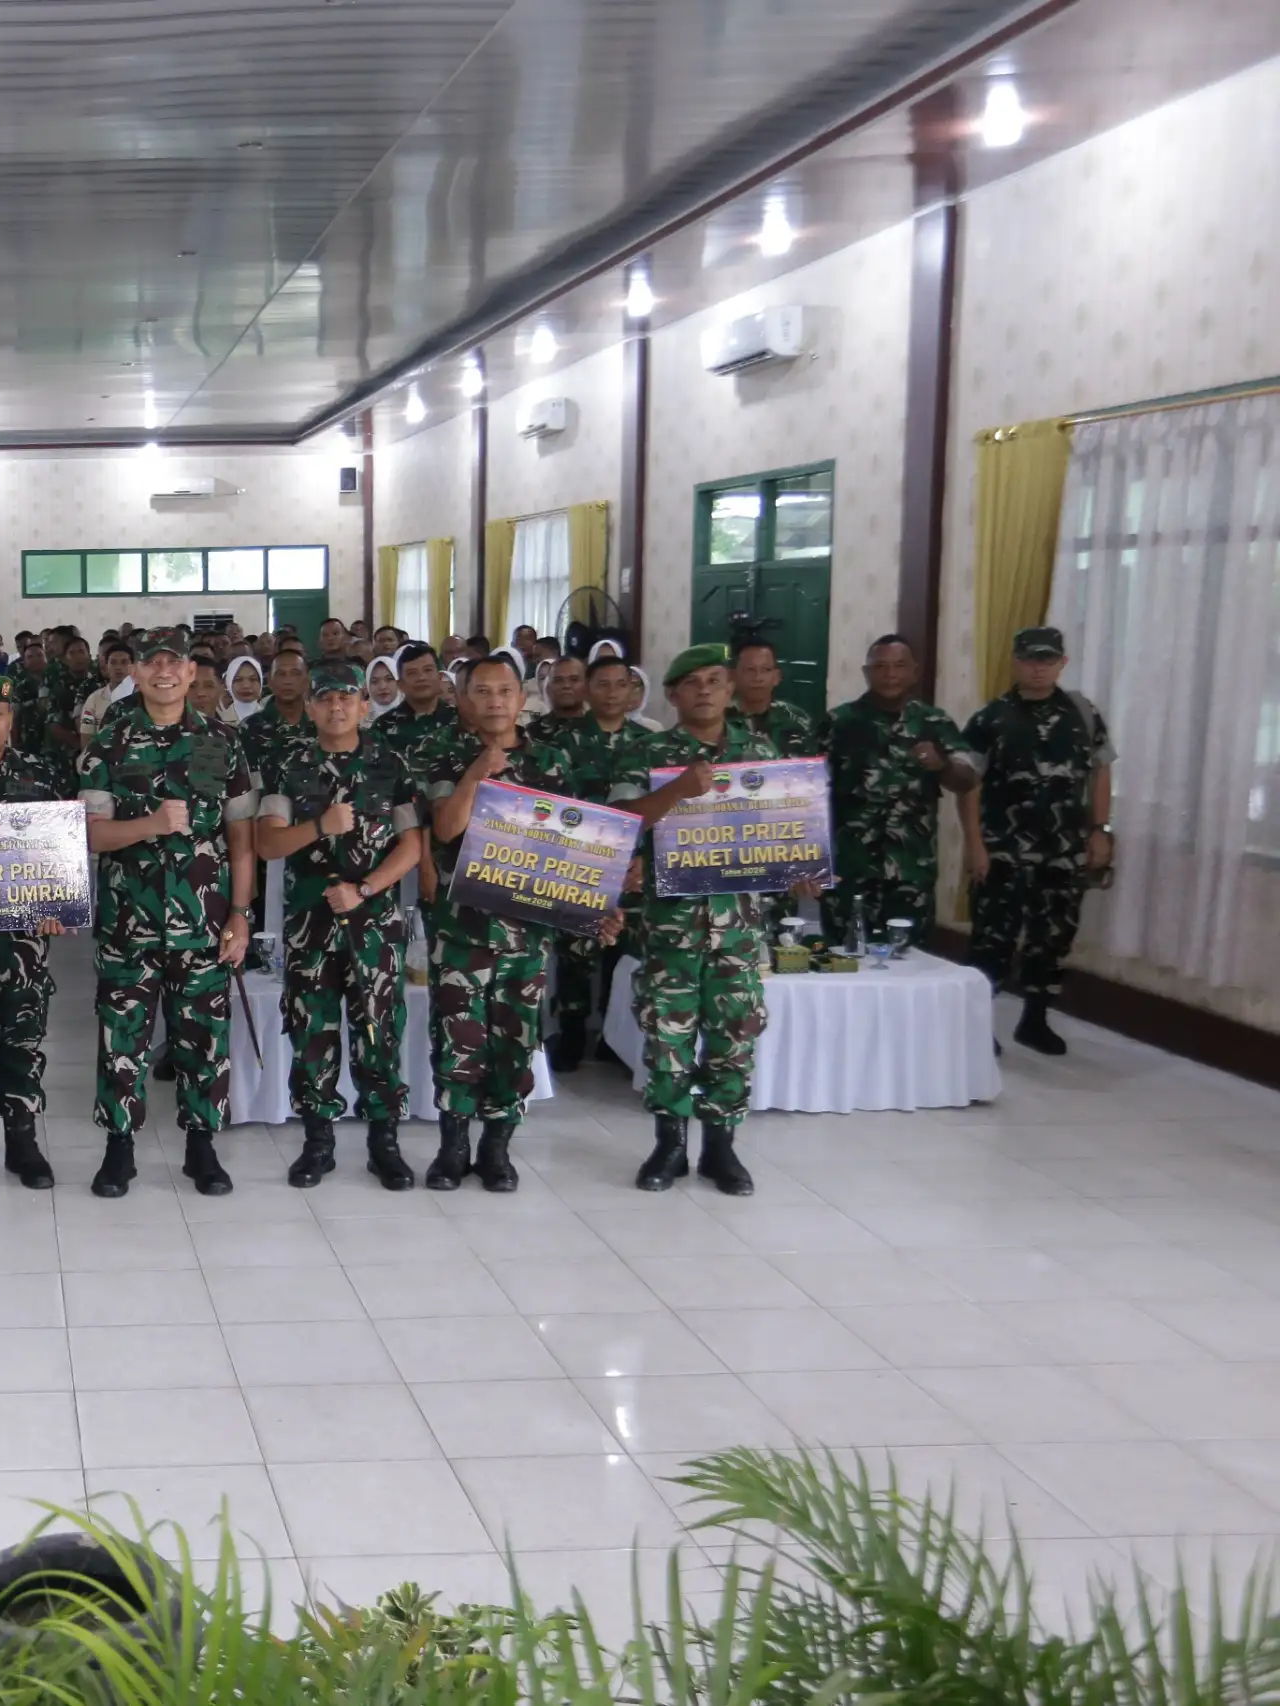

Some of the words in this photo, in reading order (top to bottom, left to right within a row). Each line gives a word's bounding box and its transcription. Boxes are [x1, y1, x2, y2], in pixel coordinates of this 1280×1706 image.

[677, 826, 735, 846] DOOR
[742, 821, 805, 841] PRIZE
[483, 842, 539, 871] DOOR
[543, 856, 604, 887] PRIZE
[667, 848, 732, 869] PAKET
[739, 843, 819, 865] UMRAH
[7, 884, 79, 903] UMRAH
[465, 861, 530, 890] PAKET
[533, 877, 608, 911] UMRAH
